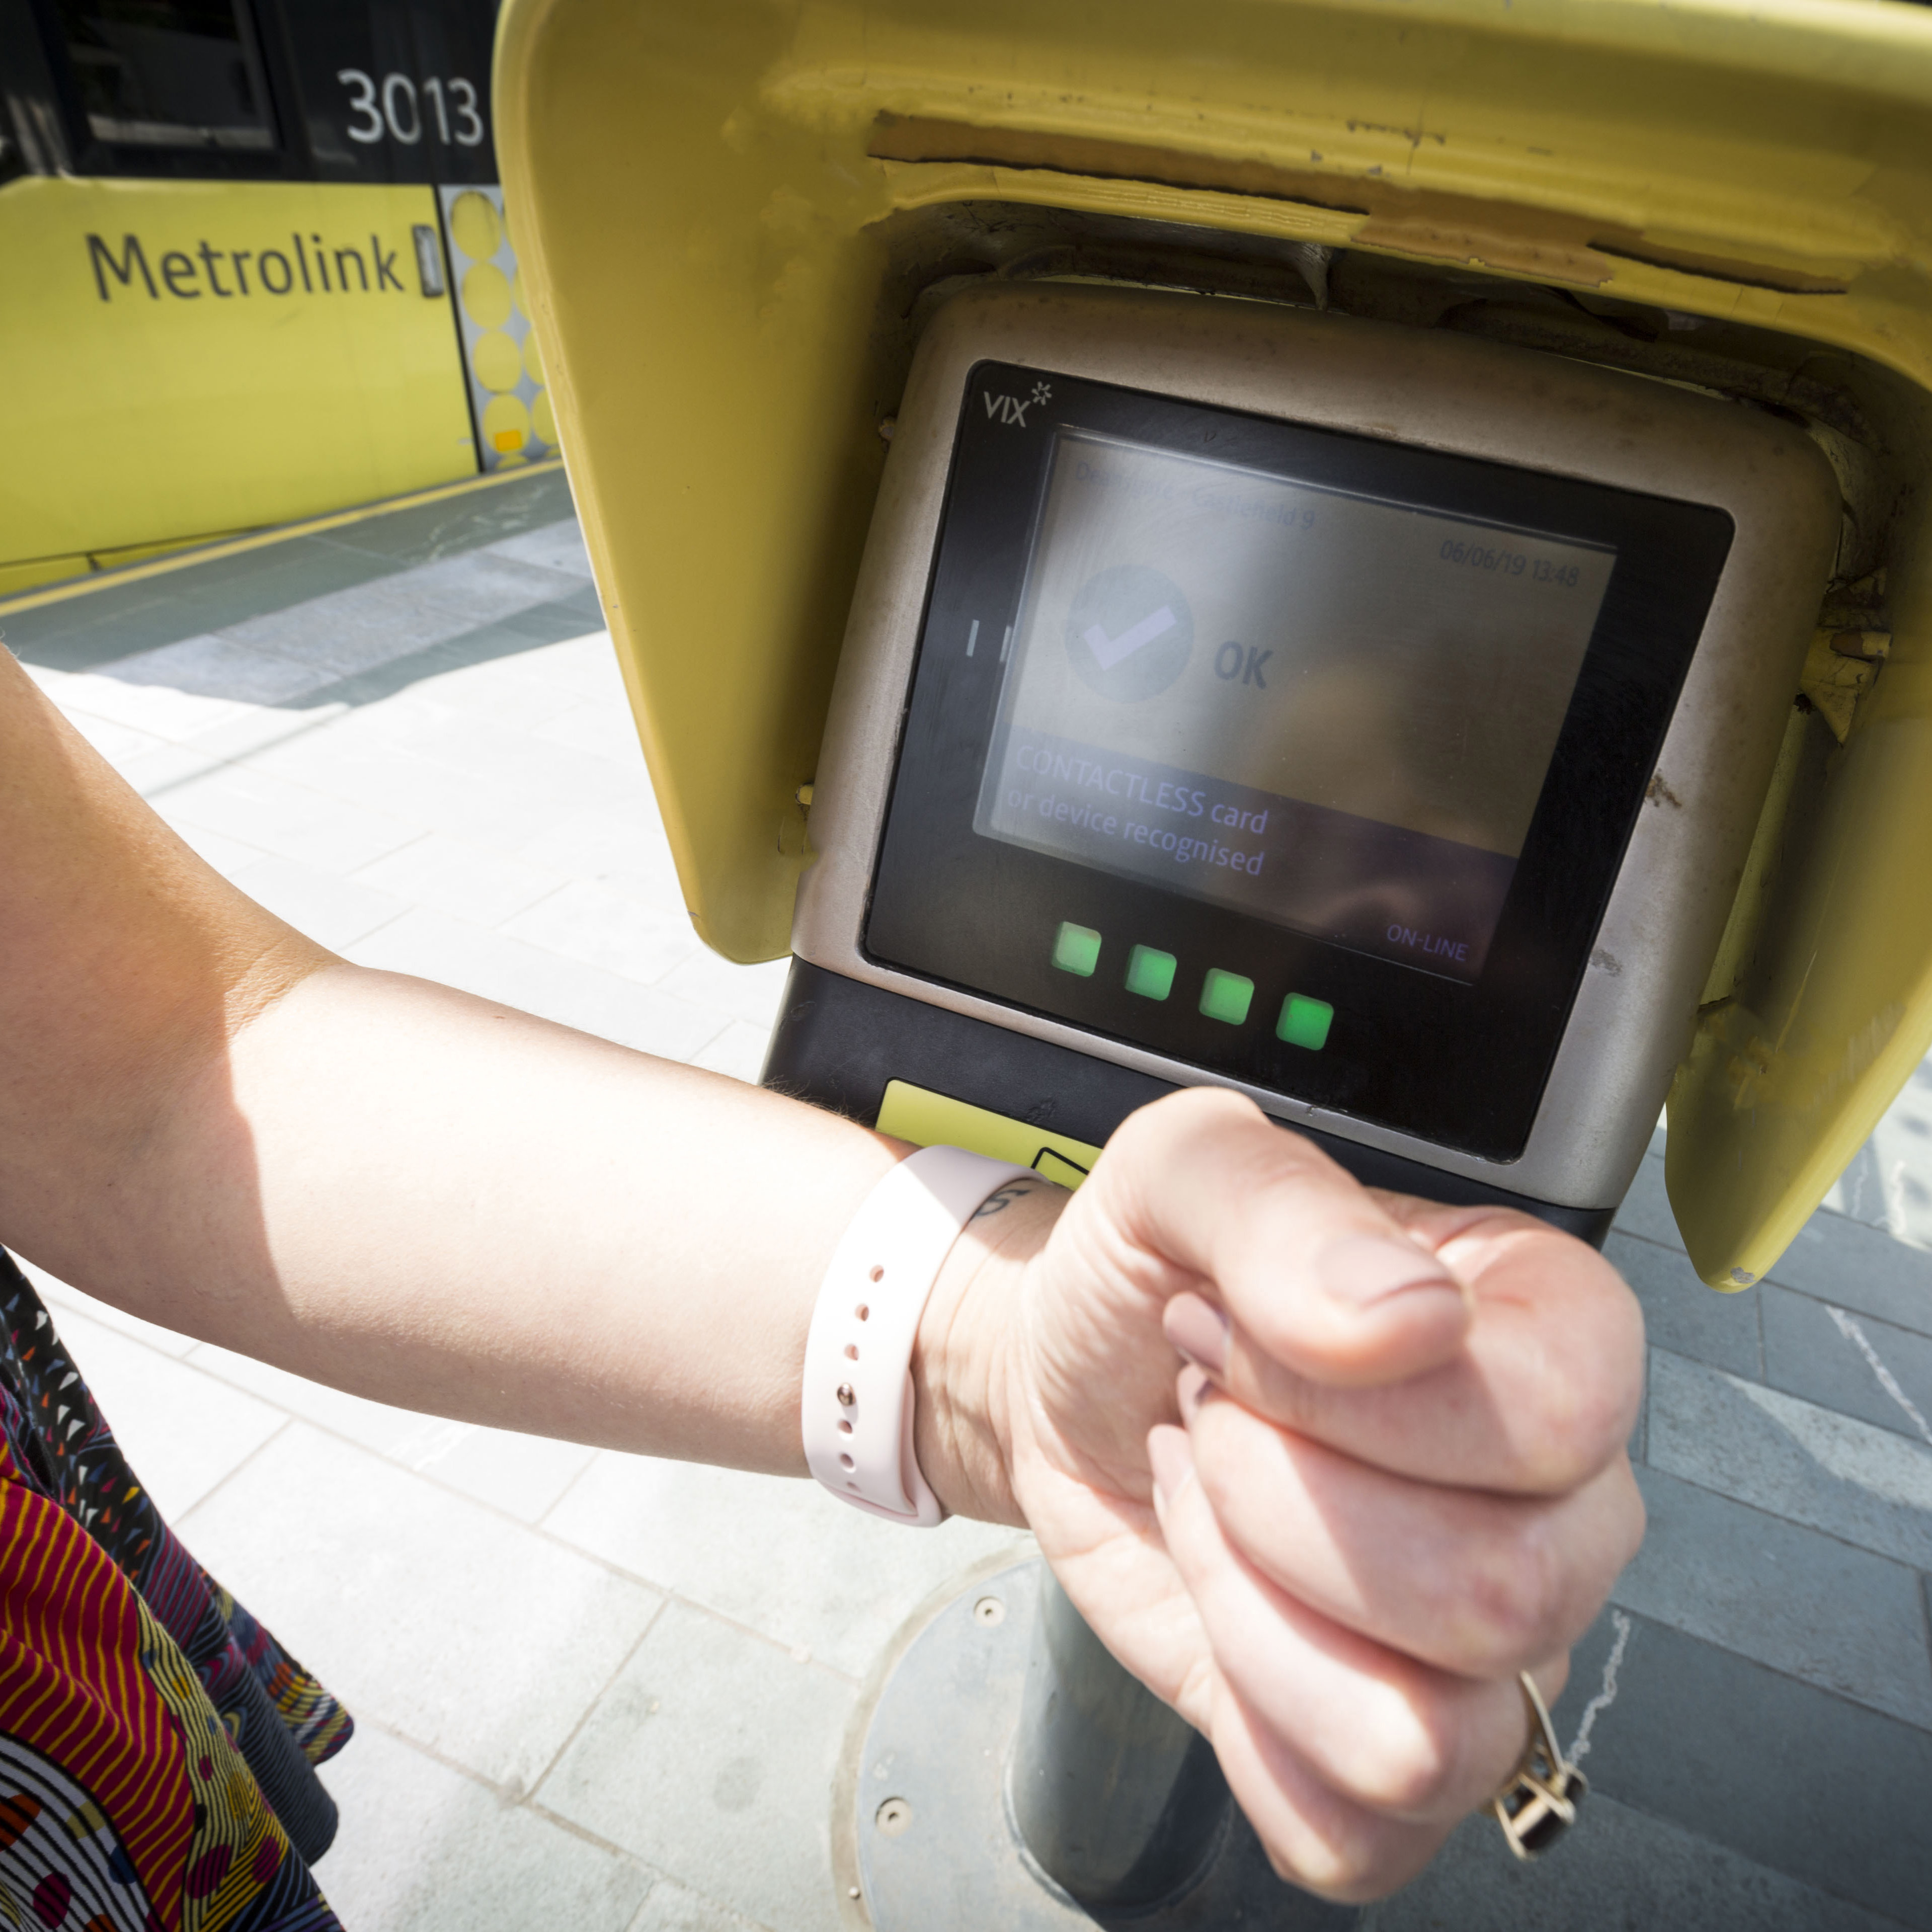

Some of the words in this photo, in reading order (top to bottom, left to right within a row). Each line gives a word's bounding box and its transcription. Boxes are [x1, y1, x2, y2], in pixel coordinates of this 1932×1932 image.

[338, 68, 484, 145] 3013
[86, 232, 406, 302] Metrolink
[984, 390, 1031, 428] VIX
[1300, 509, 1316, 531] 9
[1439, 539, 1527, 576] 06/06/19
[1533, 559, 1580, 587] 13:48
[1214, 640, 1273, 689] OK
[1016, 745, 1206, 817] CONTACTLESS
[1211, 803, 1268, 835] card
[1008, 789, 1035, 811] or
[1038, 793, 1117, 835] device
[1122, 822, 1265, 876] recognised
[1387, 924, 1469, 962] ON-LINE
